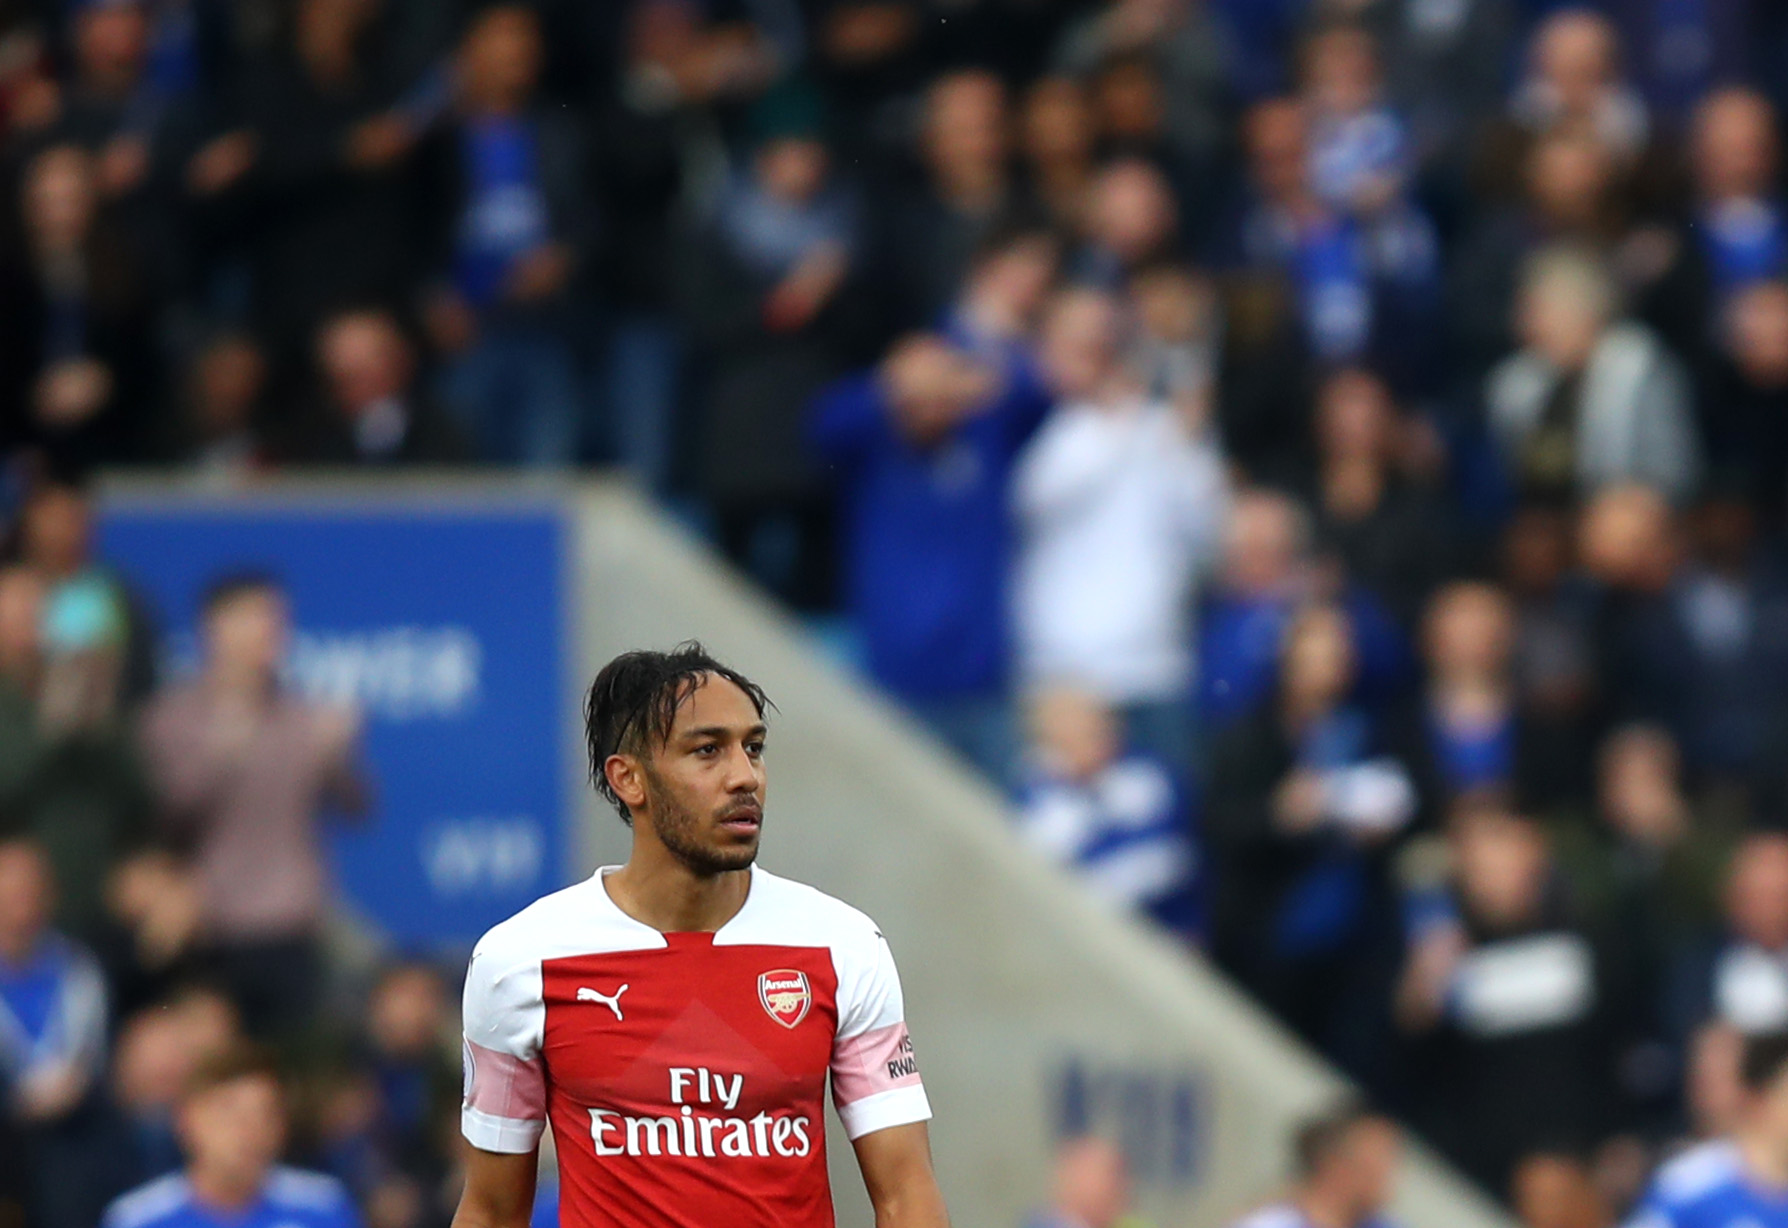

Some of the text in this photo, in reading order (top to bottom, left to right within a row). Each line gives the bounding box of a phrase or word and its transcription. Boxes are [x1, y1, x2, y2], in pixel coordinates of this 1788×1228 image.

[765, 978, 802, 990] Arsenal
[669, 1067, 744, 1110] Fly
[587, 1105, 811, 1158] Emirates
